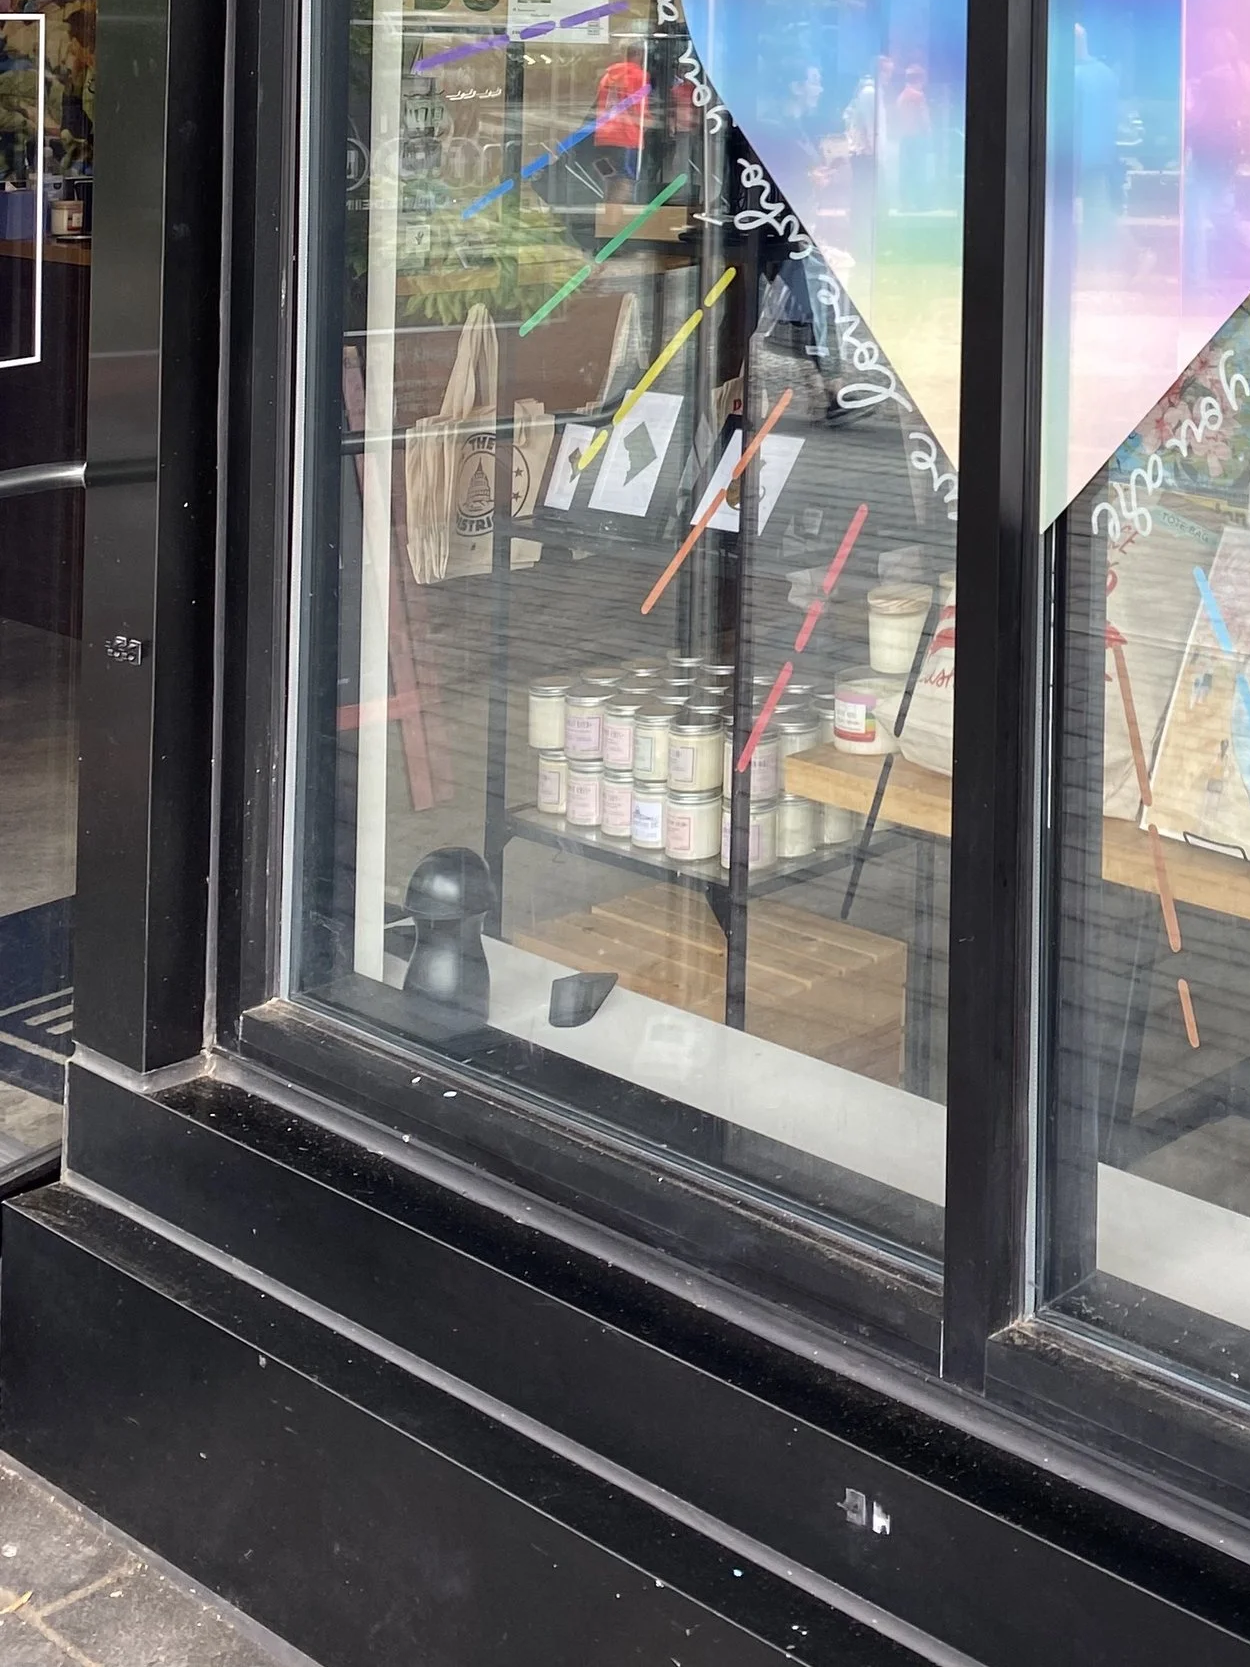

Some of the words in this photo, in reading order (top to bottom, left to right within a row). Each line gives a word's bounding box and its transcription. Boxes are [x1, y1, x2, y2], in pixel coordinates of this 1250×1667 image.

[734, 157, 813, 261] who
[818, 273, 913, 414] love
[1090, 452, 1164, 540] are
